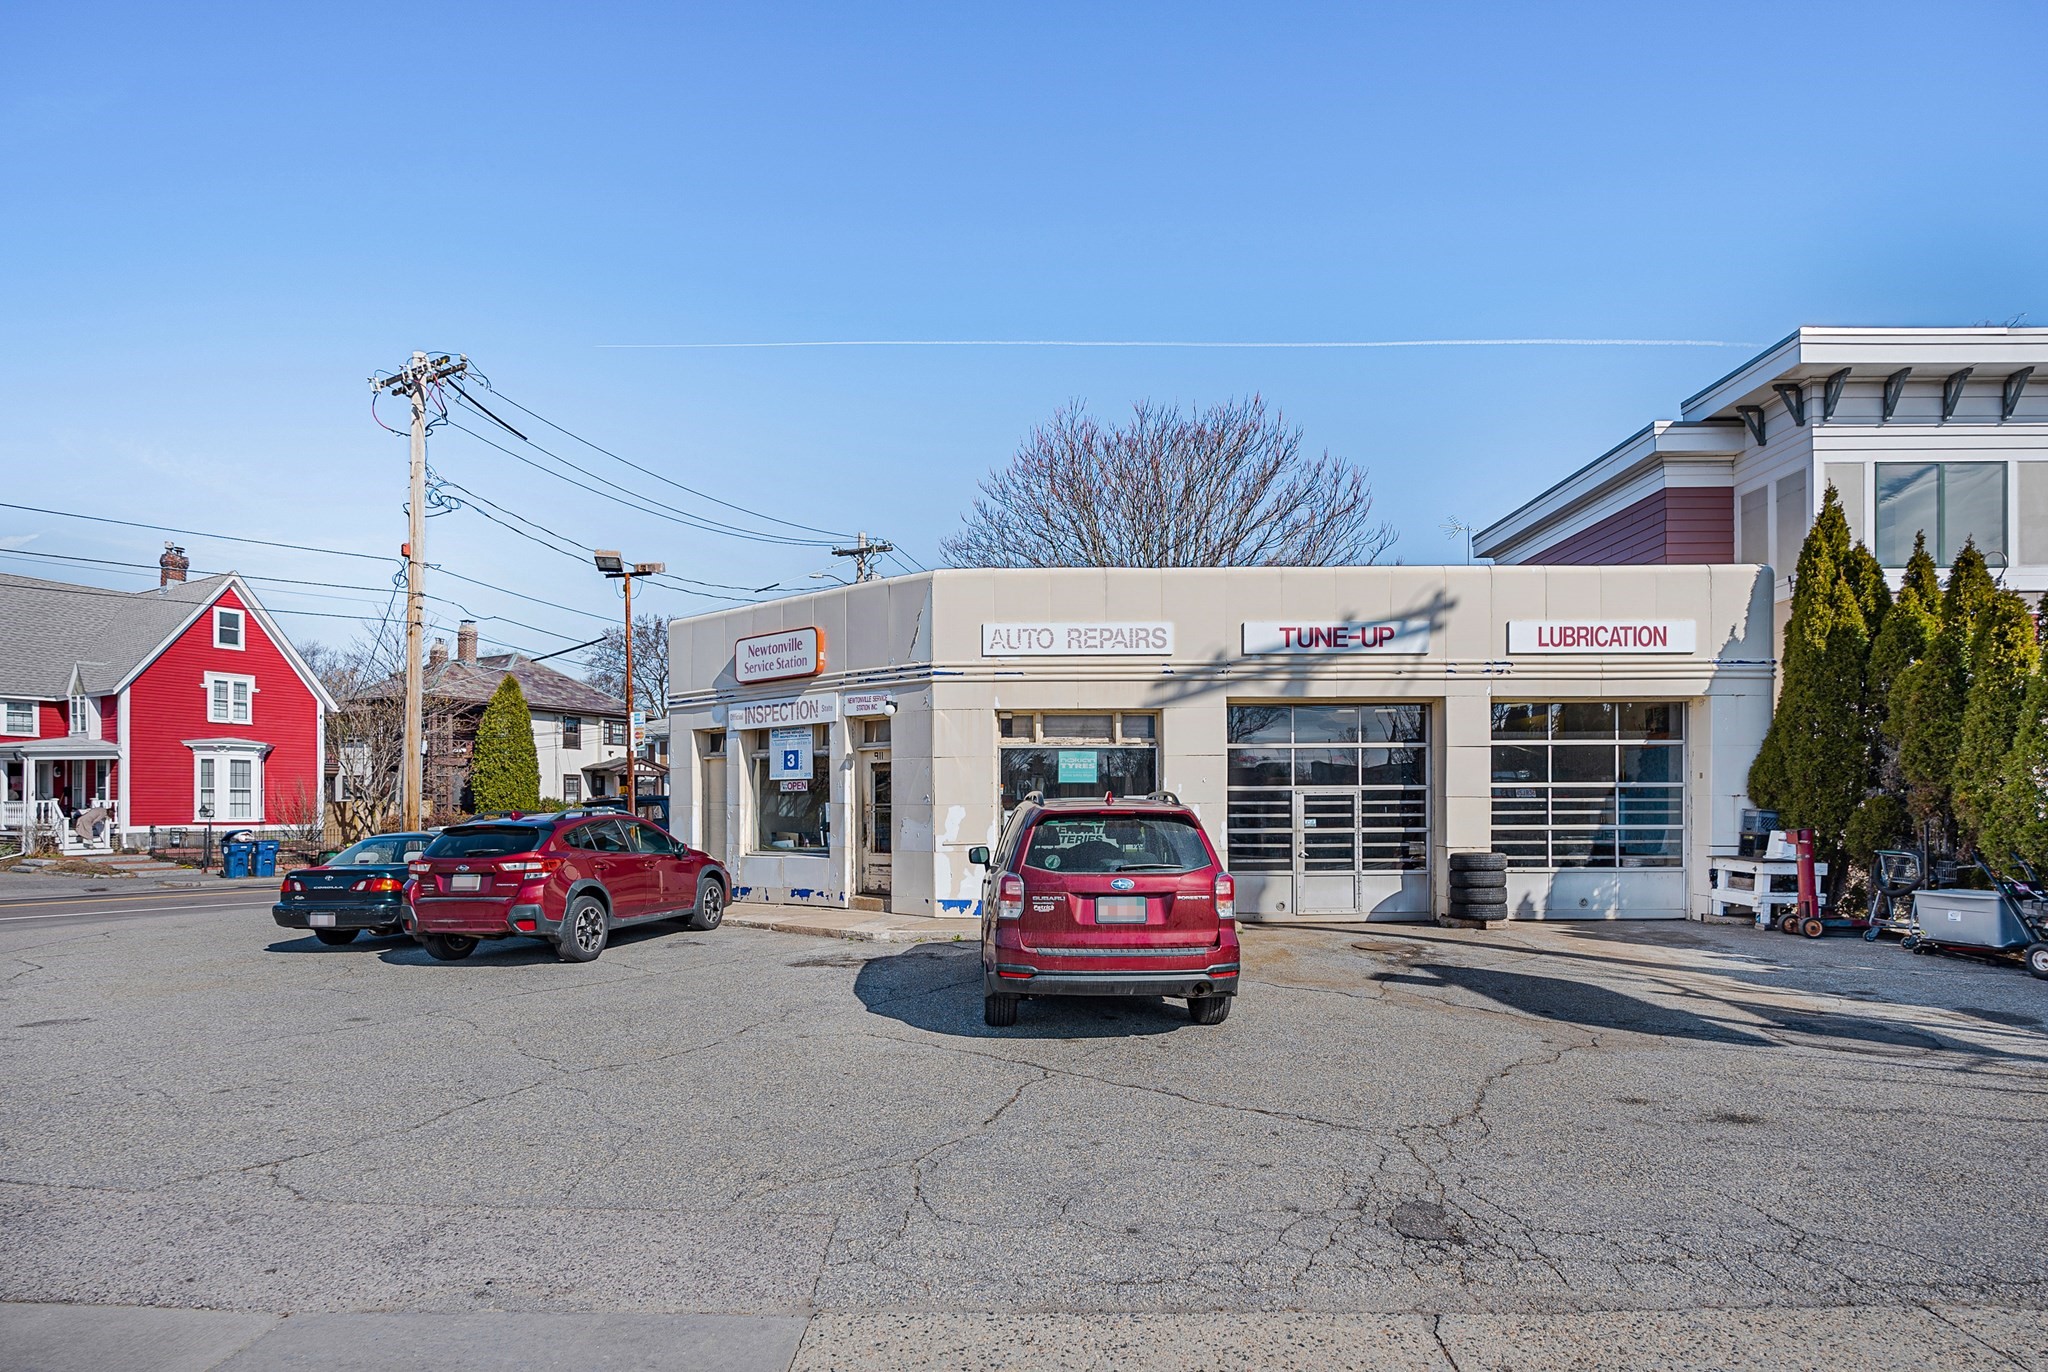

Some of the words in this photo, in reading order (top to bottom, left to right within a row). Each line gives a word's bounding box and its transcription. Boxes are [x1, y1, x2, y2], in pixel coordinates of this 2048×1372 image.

[989, 627, 1055, 650] AUTO
[1066, 627, 1168, 649] REPAIRS
[1279, 626, 1395, 648] TUNE-UP
[1537, 625, 1668, 648] LUBRICATION
[747, 637, 803, 658] Newtonville
[744, 660, 774, 674] Service
[776, 655, 808, 670] Station
[847, 696, 872, 704] NEWTONVILLE
[744, 699, 819, 725] INSPECTION
[787, 754, 795, 767] 3
[874, 751, 884, 760] 911
[787, 781, 807, 790] OPEN
[1060, 834, 1104, 844] TERIES
